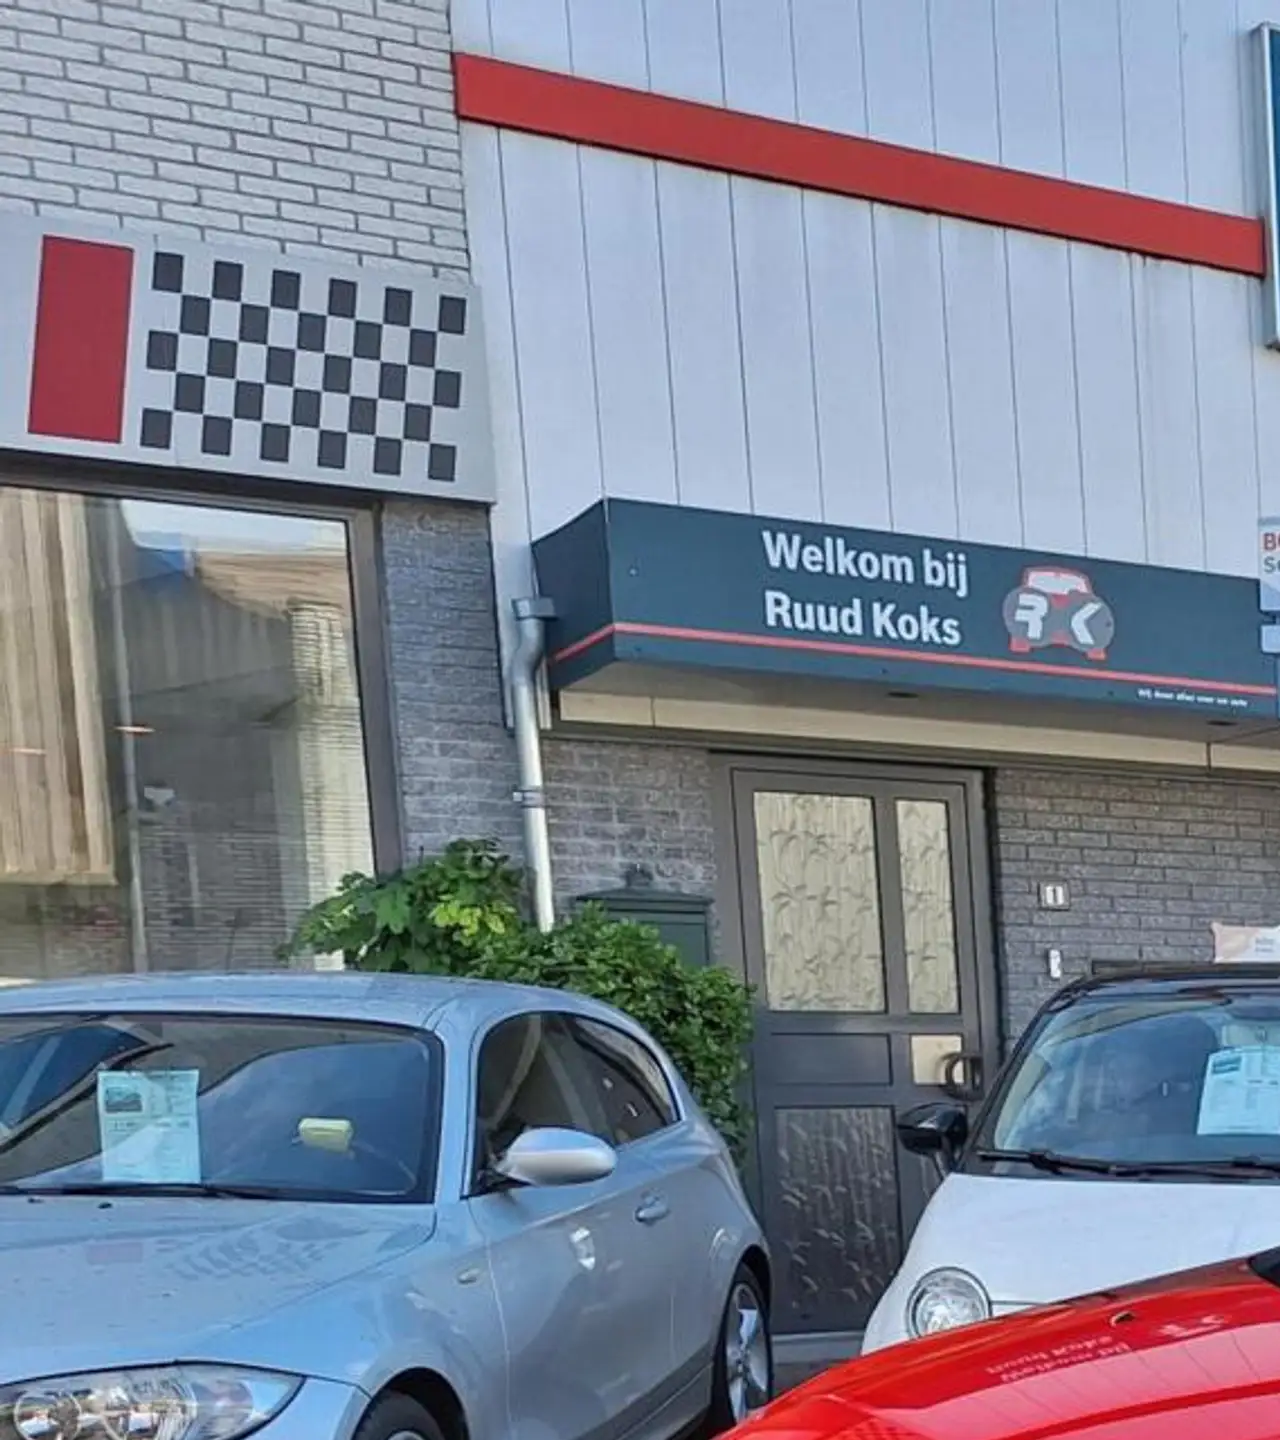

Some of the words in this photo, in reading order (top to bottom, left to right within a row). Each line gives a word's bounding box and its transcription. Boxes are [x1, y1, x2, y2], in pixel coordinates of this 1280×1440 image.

[762, 530, 914, 584] Welkom
[923, 548, 968, 598] bij
[764, 590, 864, 638] Ruud
[872, 602, 962, 646] Koks
